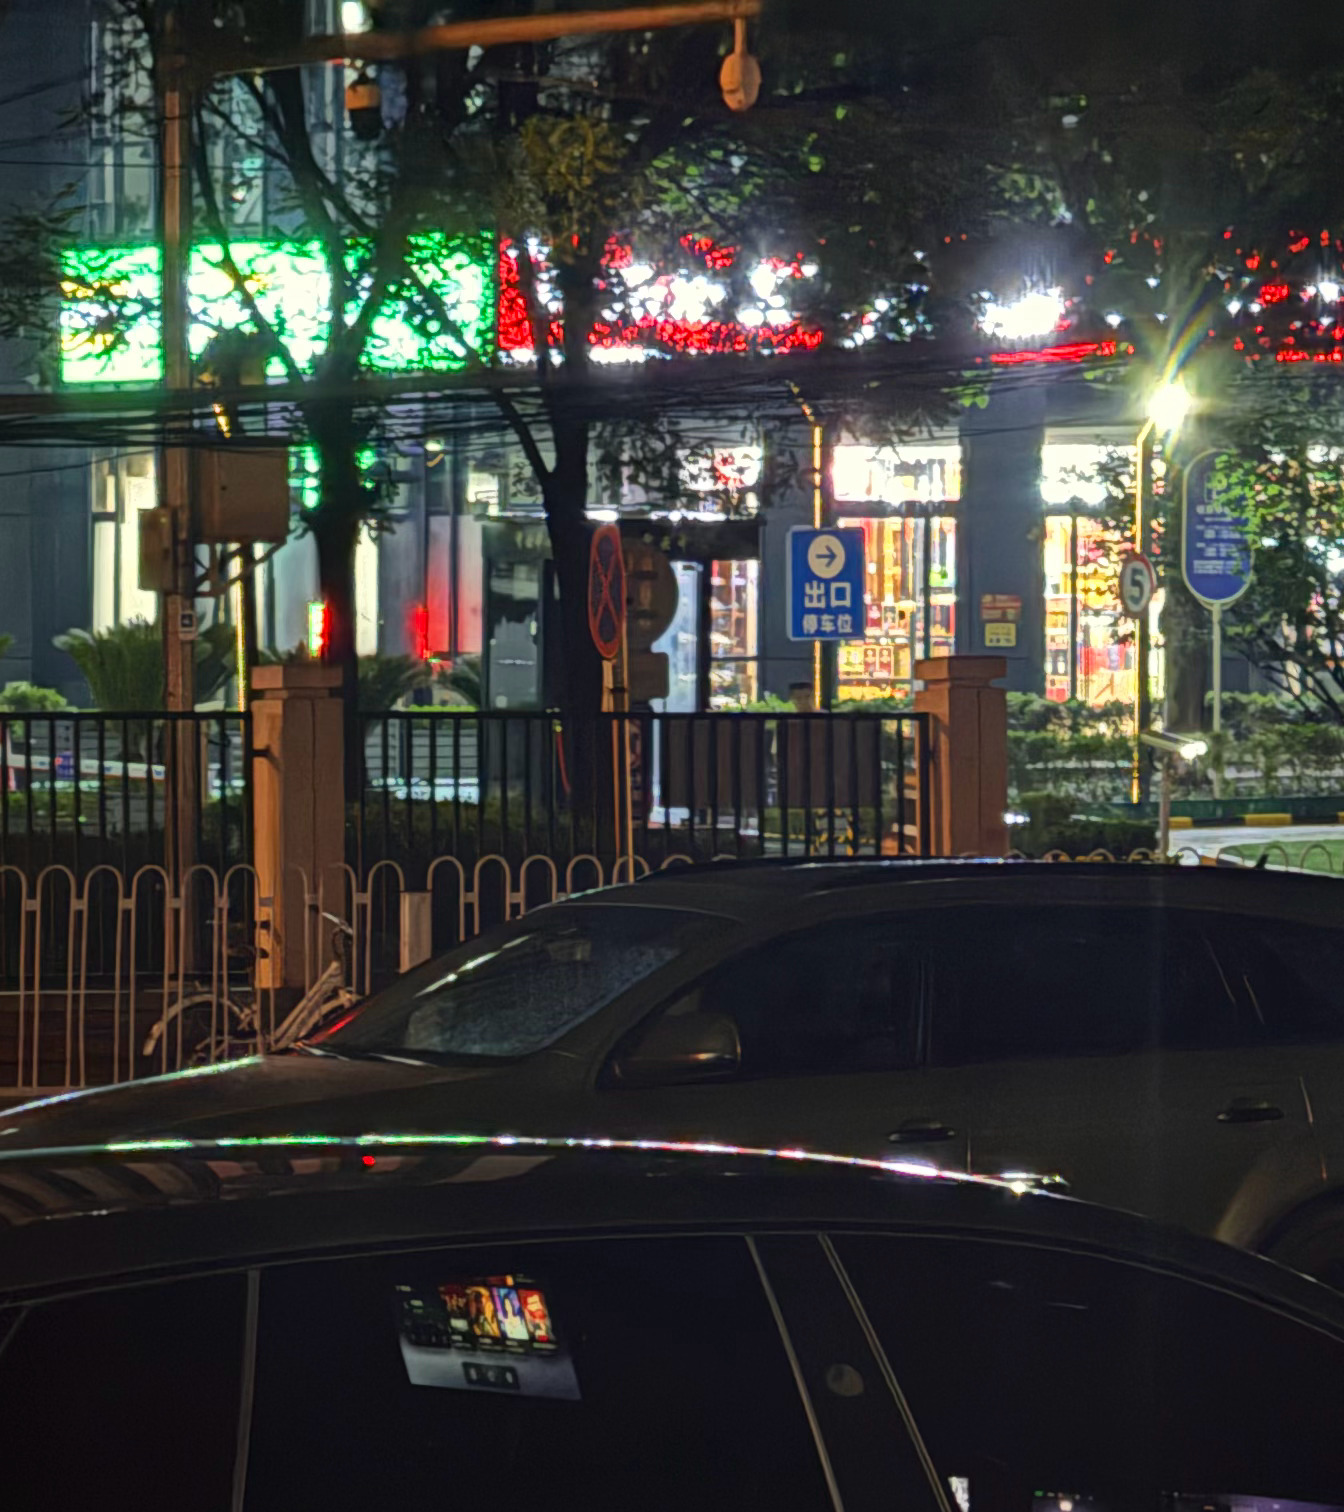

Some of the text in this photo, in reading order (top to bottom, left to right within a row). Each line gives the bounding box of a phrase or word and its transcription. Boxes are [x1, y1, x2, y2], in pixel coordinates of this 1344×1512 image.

[804, 580, 852, 609] 出口
[1131, 568, 1145, 604] 5
[802, 613, 853, 634] 停车位
